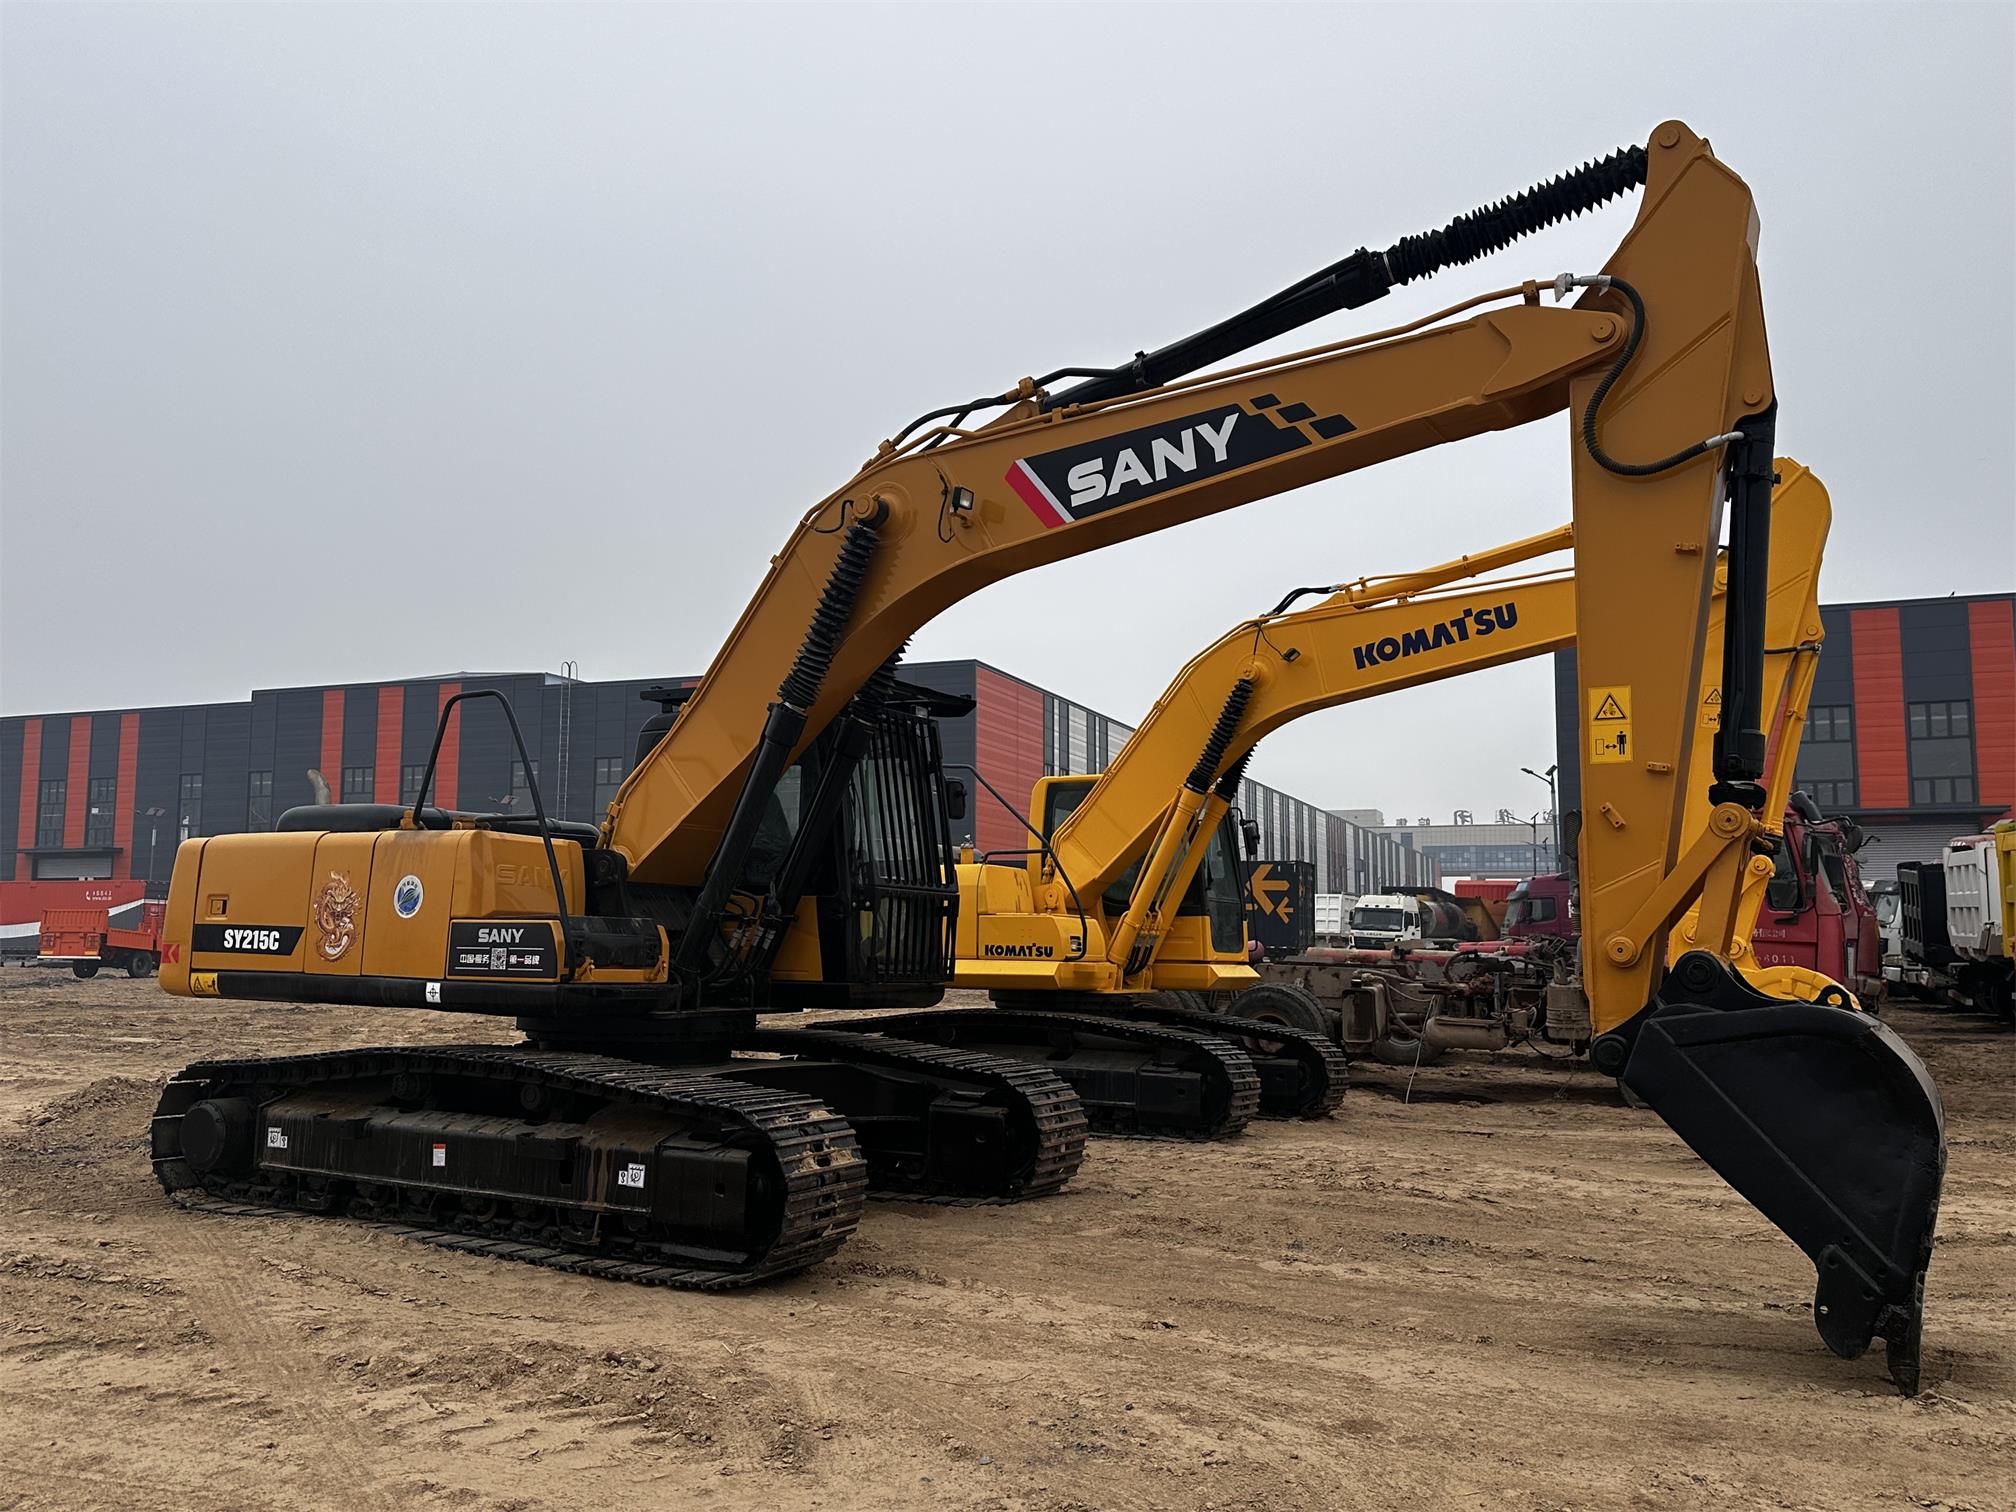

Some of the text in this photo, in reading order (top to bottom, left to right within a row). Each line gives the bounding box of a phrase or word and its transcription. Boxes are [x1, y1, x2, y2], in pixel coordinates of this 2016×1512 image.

[1067, 412, 1239, 508] SANY
[1353, 602, 1518, 670] KOMATSU
[223, 929, 280, 950] SY215C
[478, 928, 525, 943] SANY
[984, 943, 1054, 958] KOMATSU
